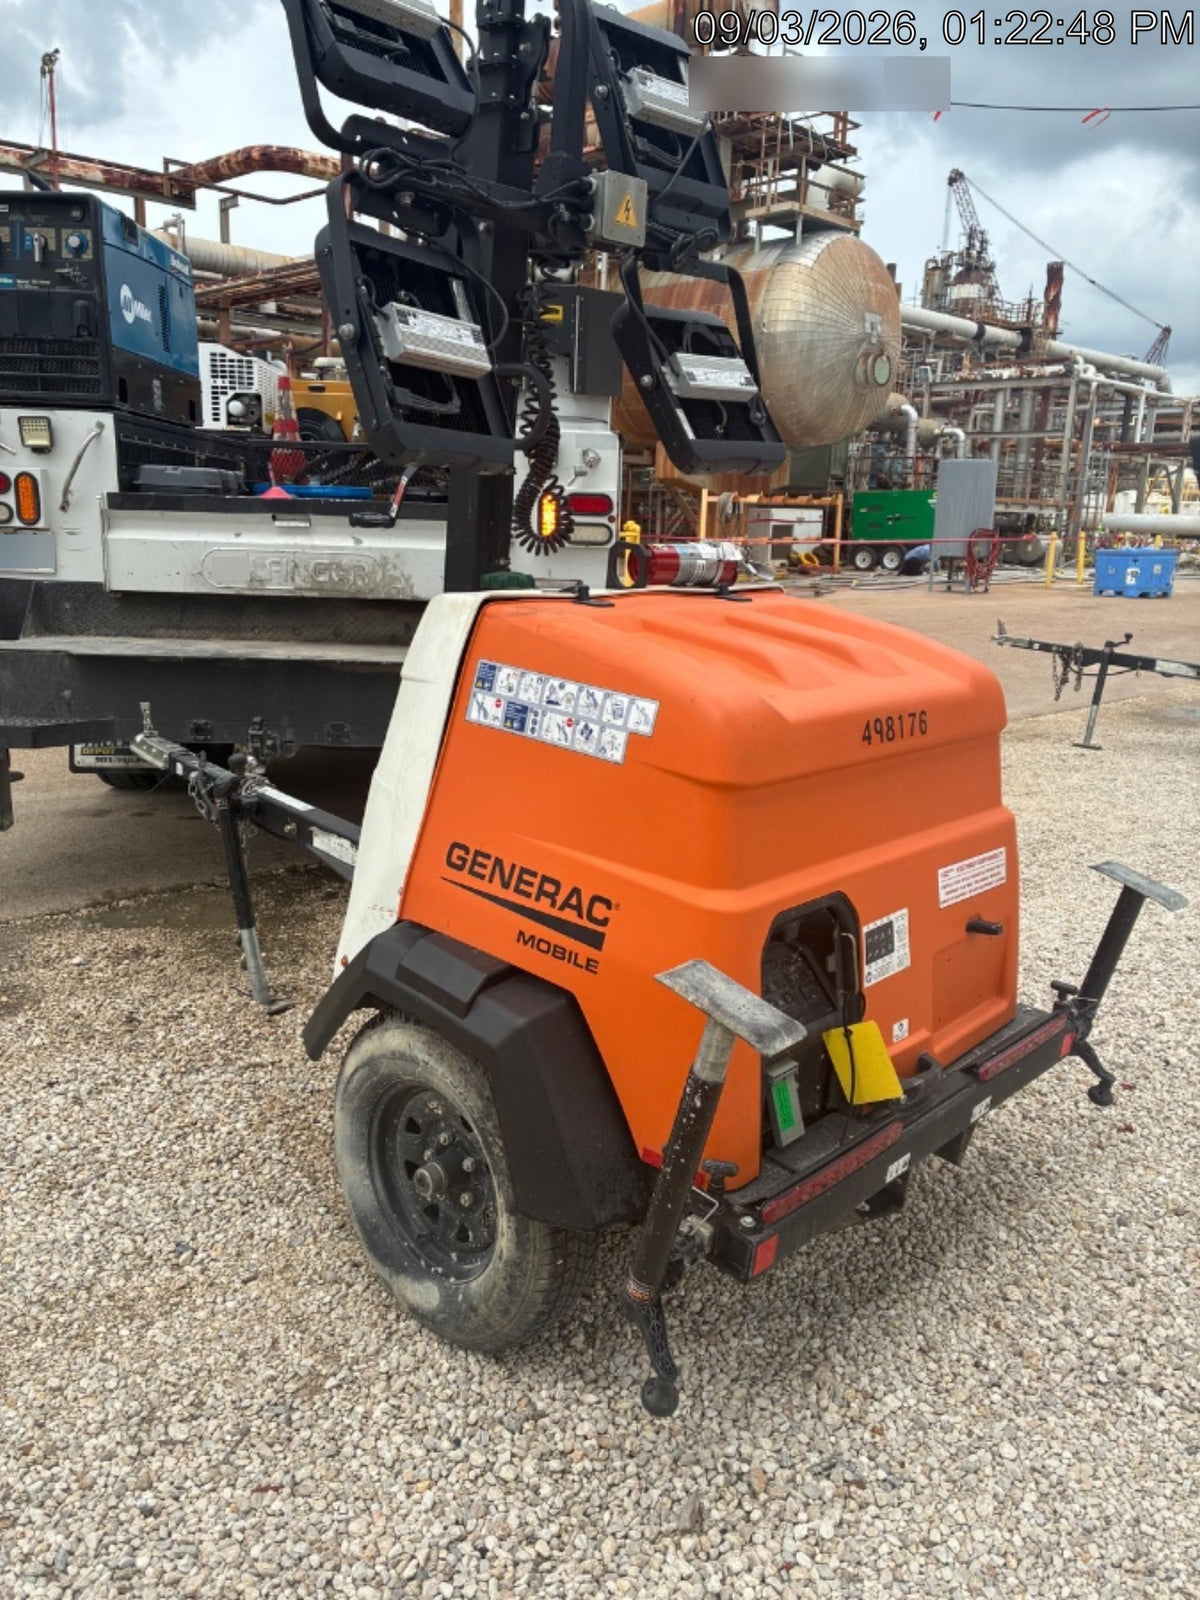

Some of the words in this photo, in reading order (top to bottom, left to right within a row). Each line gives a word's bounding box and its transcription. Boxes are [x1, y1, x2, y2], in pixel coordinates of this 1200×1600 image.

[862, 710, 927, 746] 498176
[445, 841, 613, 927] GENERAC
[516, 929, 600, 975] MOBILE
